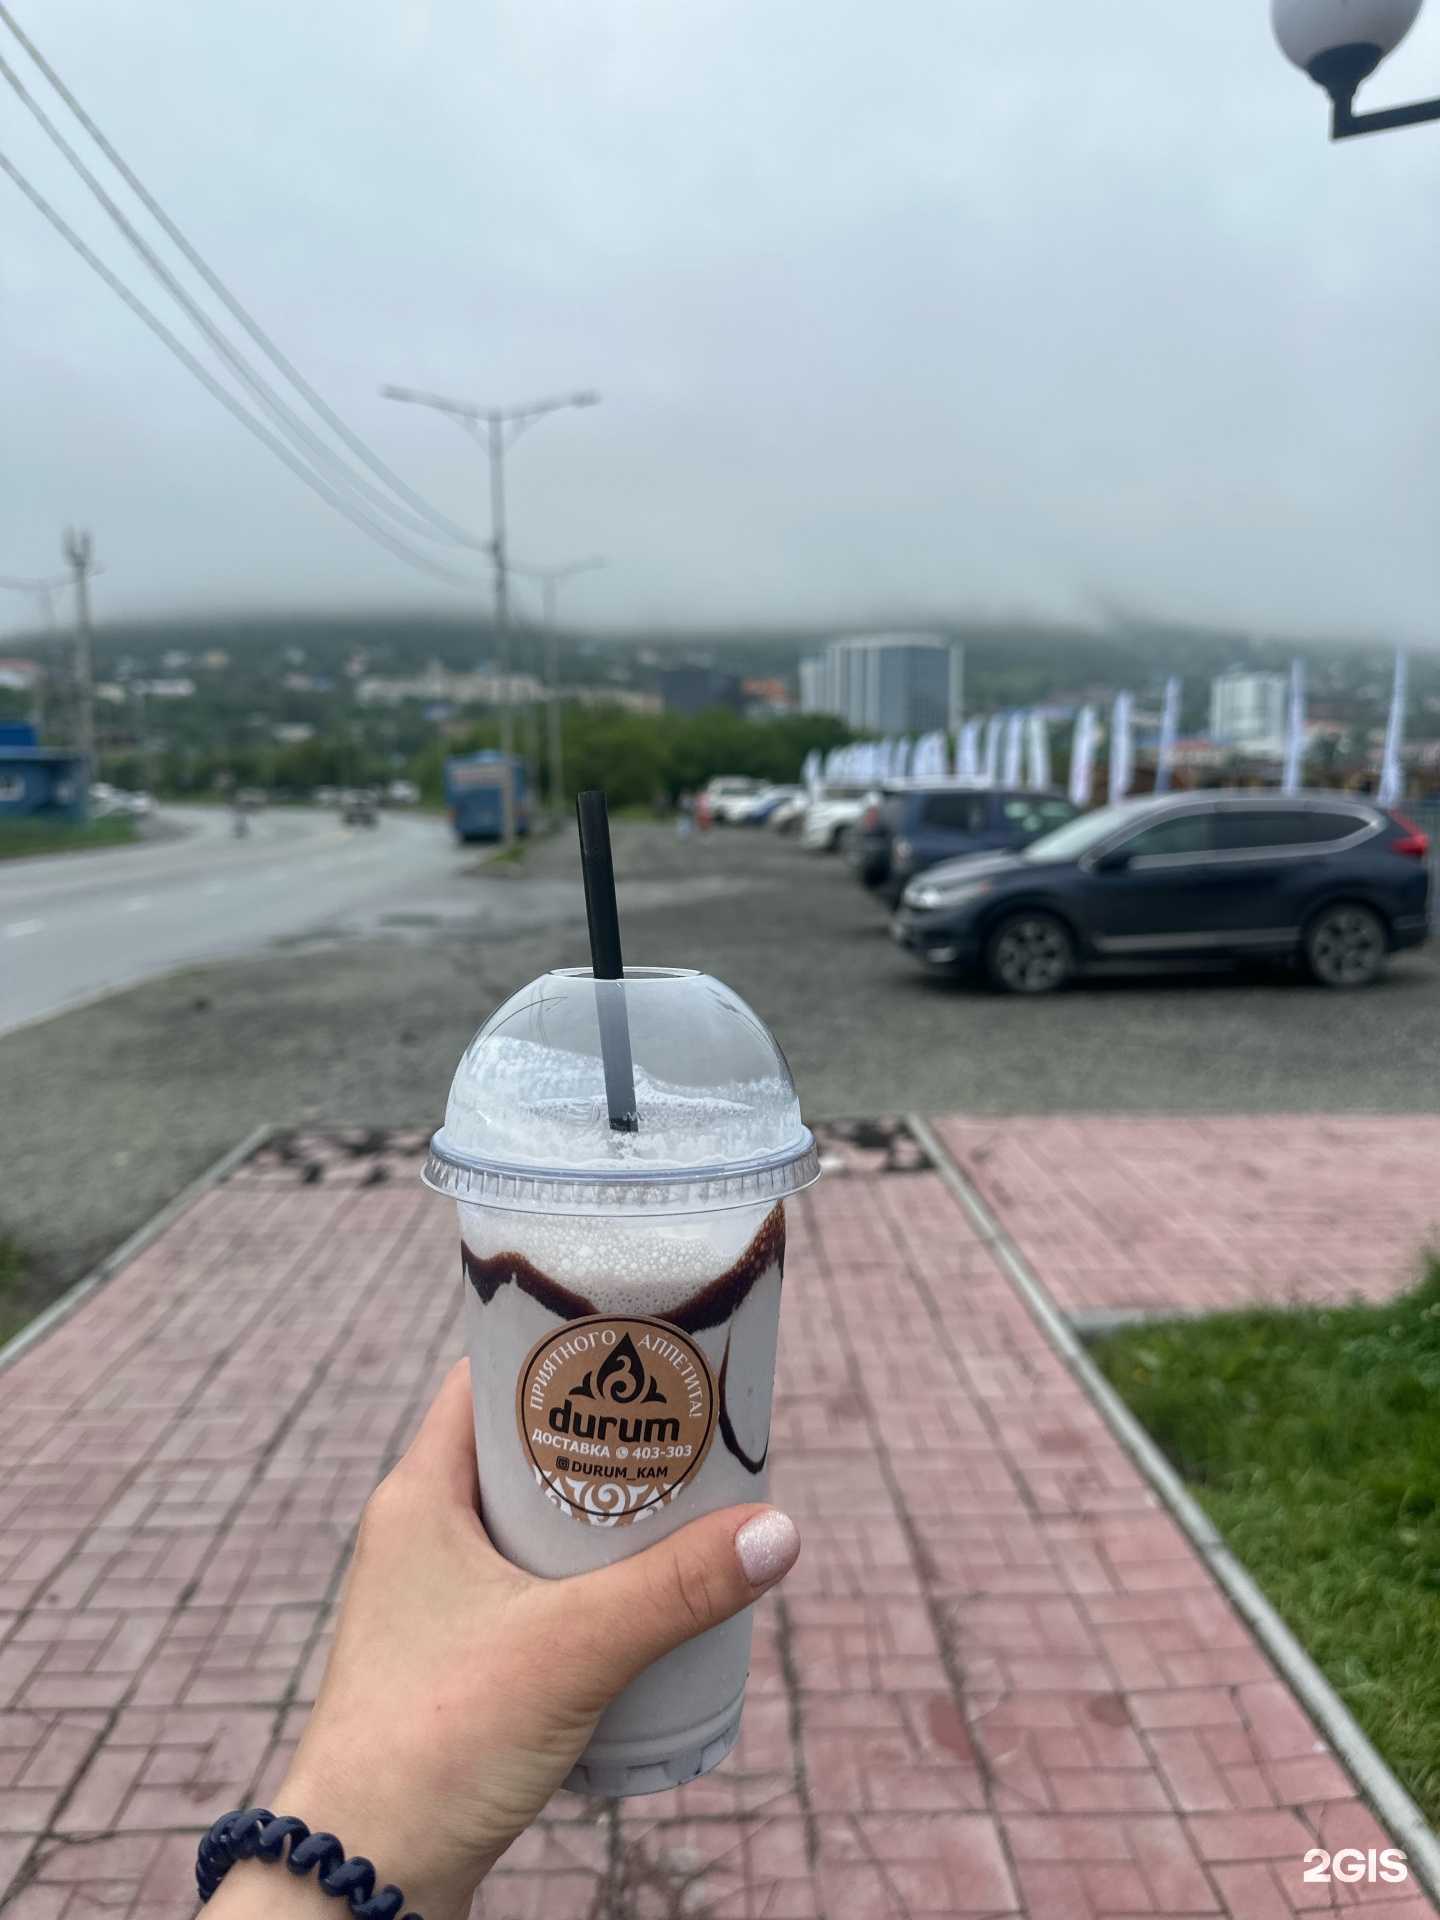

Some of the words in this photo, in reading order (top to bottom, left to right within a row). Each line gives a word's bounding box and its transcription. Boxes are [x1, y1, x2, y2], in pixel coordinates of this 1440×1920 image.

[530, 1329, 617, 1411] ПРИЯТНОГО
[637, 1333, 704, 1418] АППЕТИТА!
[548, 1399, 680, 1443] durum
[532, 1428, 610, 1458] ДОСТАВКА
[632, 1444, 693, 1460] 403-303
